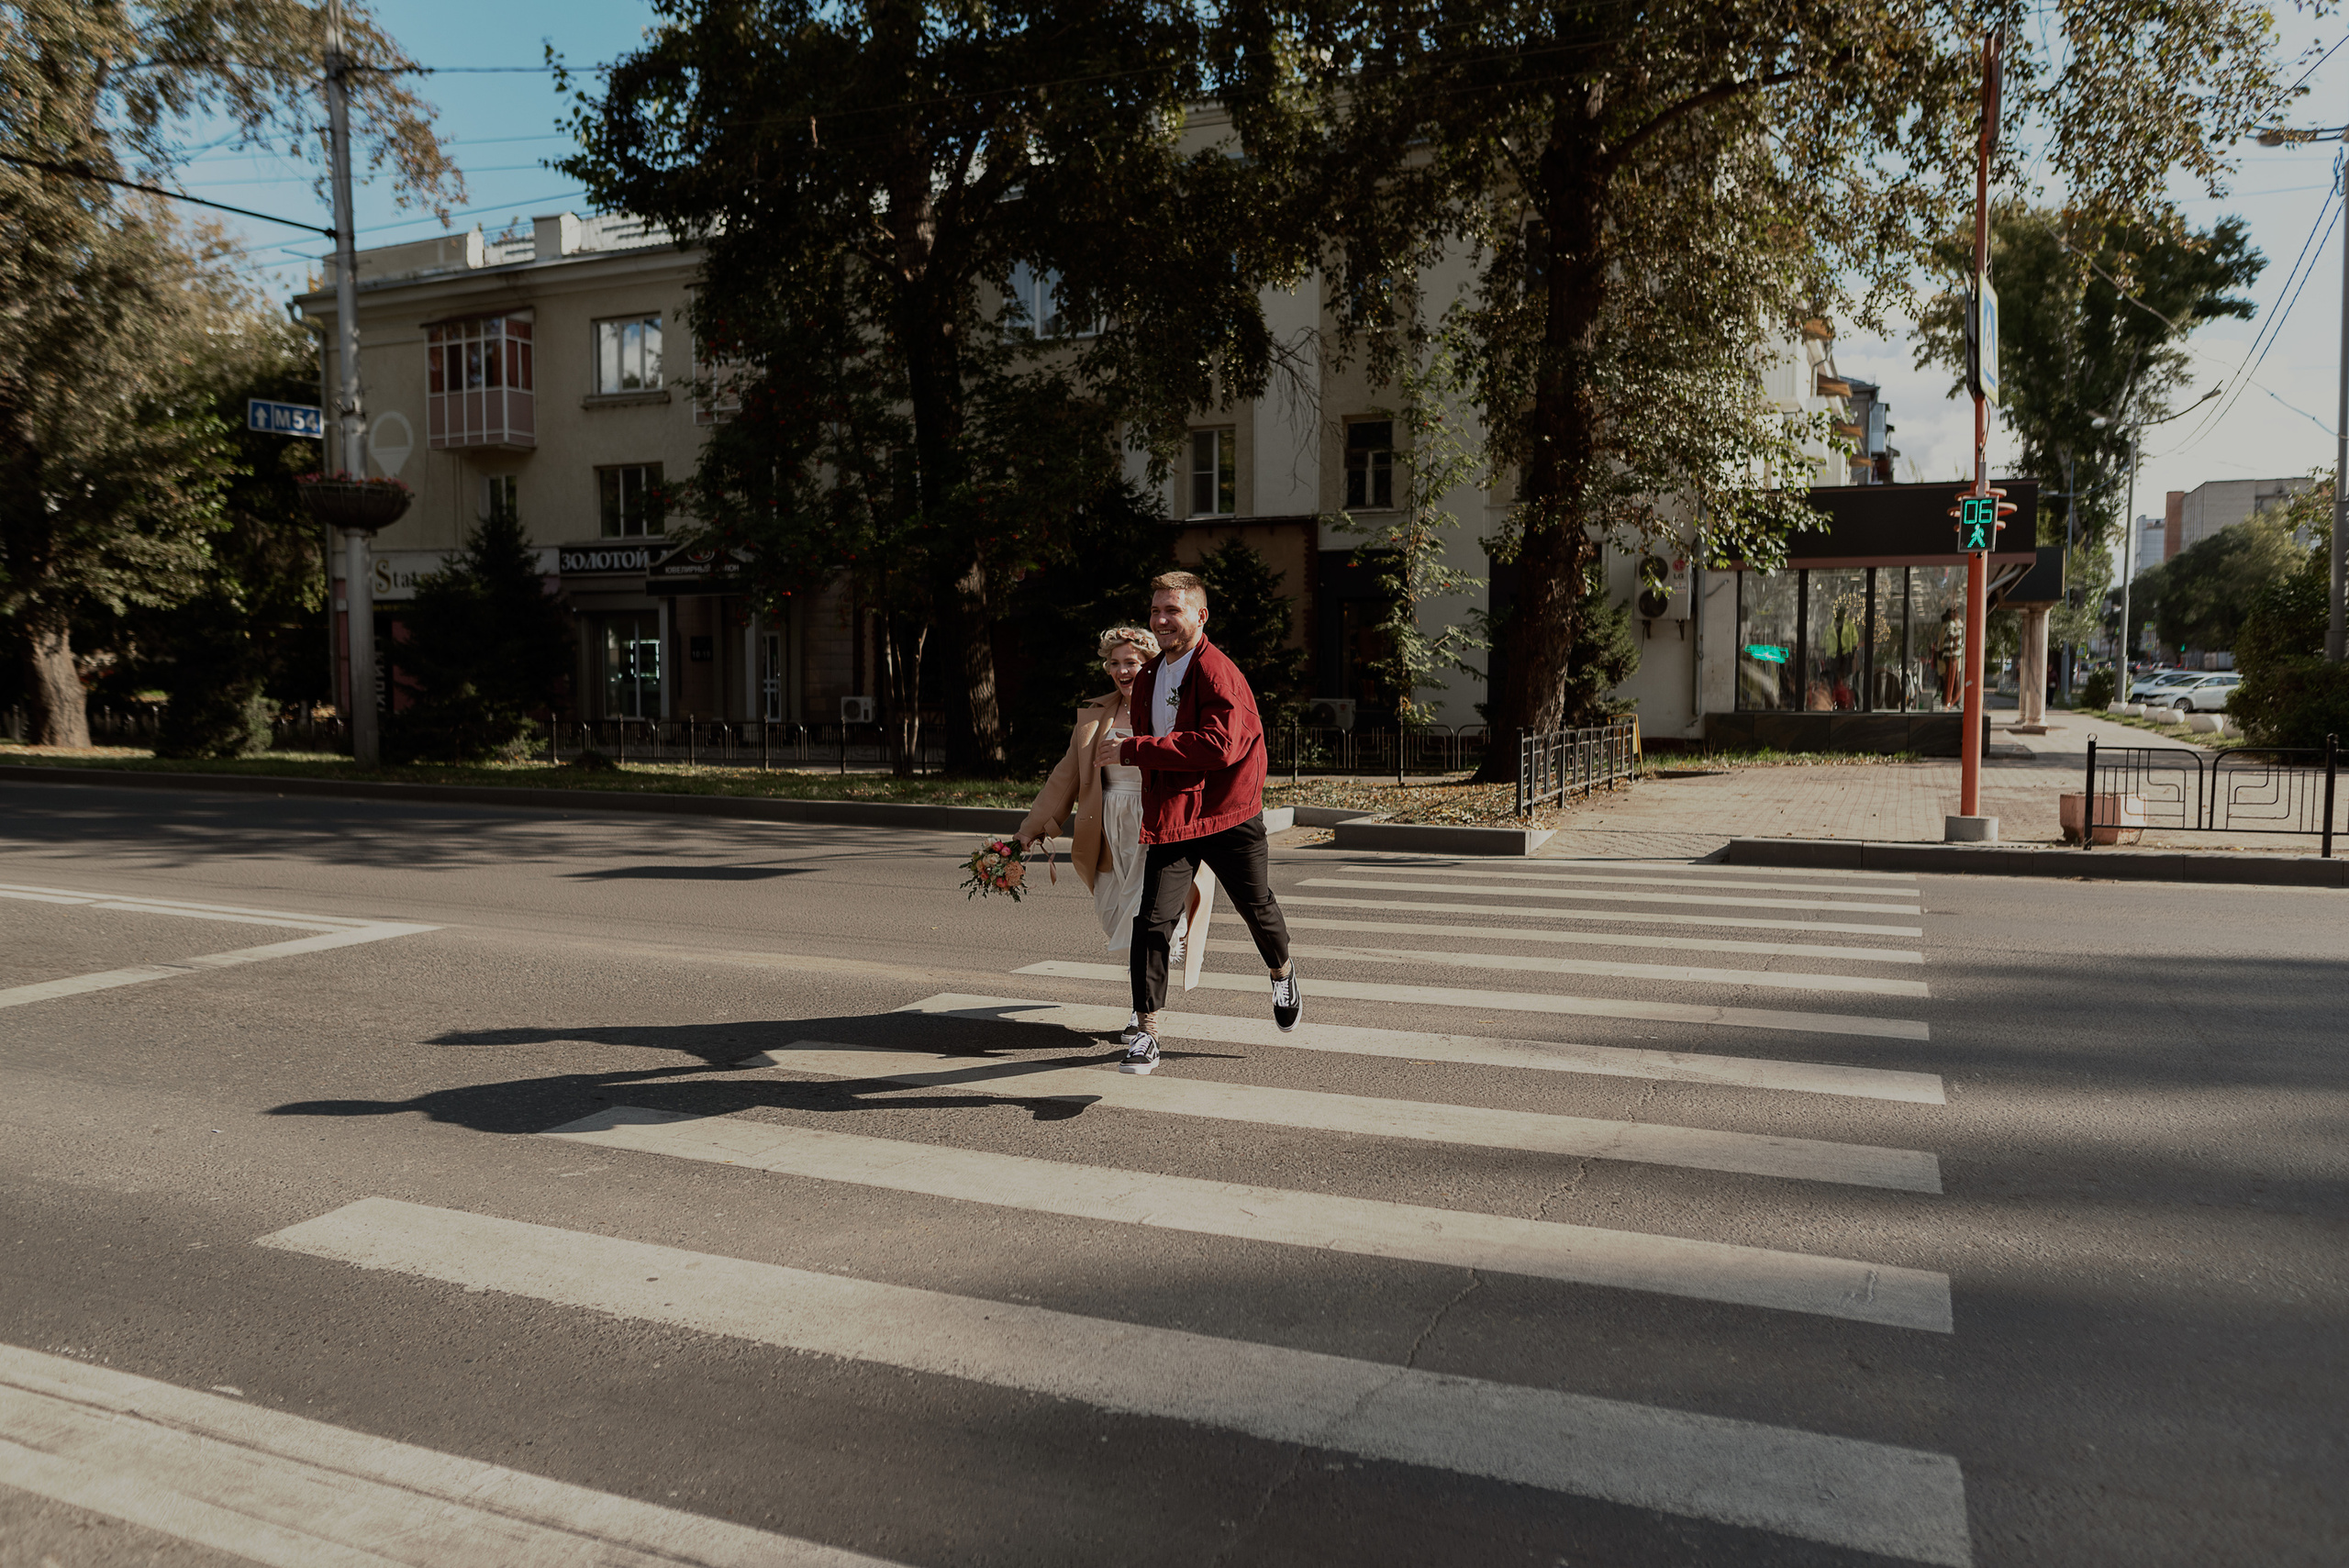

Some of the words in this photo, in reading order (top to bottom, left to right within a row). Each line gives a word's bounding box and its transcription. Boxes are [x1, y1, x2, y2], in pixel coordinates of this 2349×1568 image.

[1963, 498, 1993, 525] 06
[561, 546, 650, 571] ЗОЛОТОЙ
[664, 562, 711, 574] ЮВЕЛИРНЫЙ
